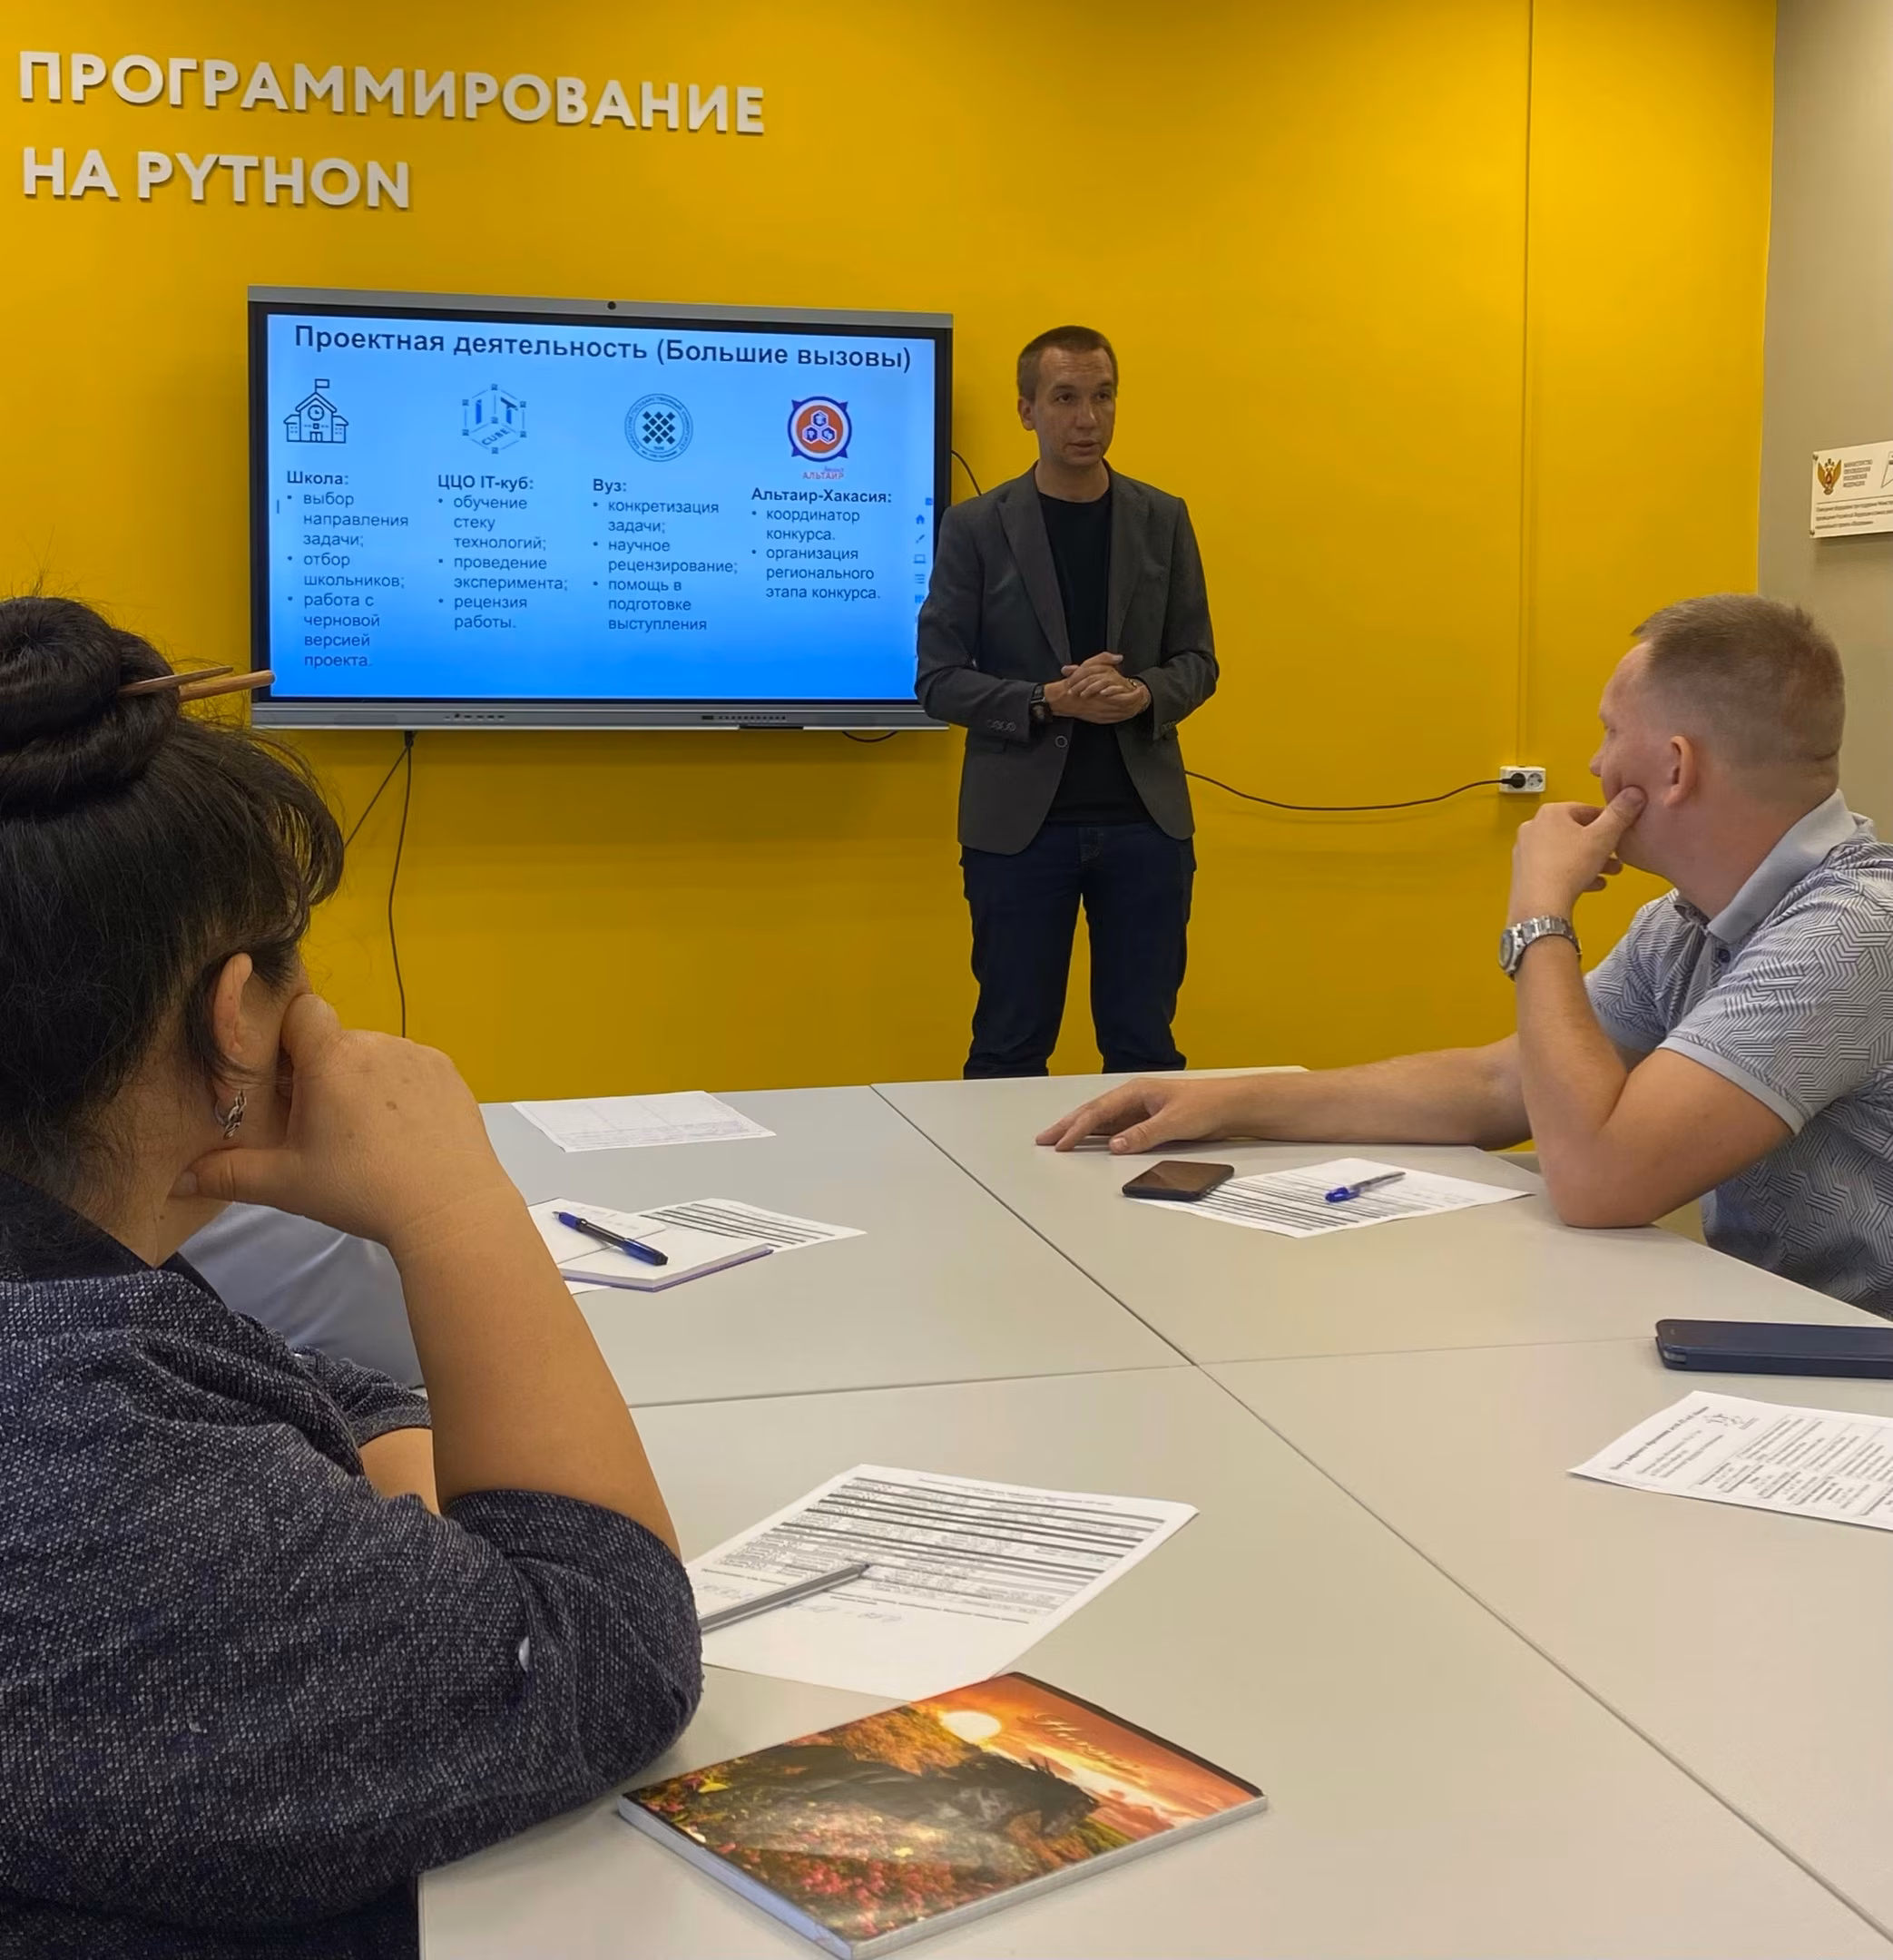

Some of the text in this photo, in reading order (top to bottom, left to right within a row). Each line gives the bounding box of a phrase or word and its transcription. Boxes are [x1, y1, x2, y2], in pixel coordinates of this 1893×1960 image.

[19, 50, 765, 134] ПРОГРАММИРОВАНИЕ
[23, 147, 410, 210] НА PYTHON
[295, 325, 911, 373] Проектная деятельность (Большие вызовы)
[287, 470, 348, 485] Школа:
[437, 475, 534, 493] ЦЦО IT-куб:
[593, 478, 627, 495] Вуз:
[303, 492, 354, 508] выбор
[751, 487, 892, 504] Альтаир-Хакасия:
[454, 495, 527, 512] обучение
[608, 501, 720, 514] конкретизация
[303, 514, 408, 528] направления
[766, 509, 860, 524] координатор
[454, 517, 495, 532] стеку
[608, 521, 665, 534] задачи;
[303, 534, 364, 548] задачи;
[454, 536, 546, 551] технологий;
[766, 529, 836, 543] конкурса.
[608, 541, 670, 554] научное
[766, 548, 858, 562] организация
[303, 552, 350, 569] отбор
[454, 557, 547, 571] проведение
[608, 560, 738, 574] рецензирование;
[766, 567, 874, 581] регионального
[304, 575, 405, 589] школьников;
[454, 577, 568, 592] эксперимента;
[608, 580, 682, 593] помощь в
[304, 593, 375, 609] работа с
[766, 587, 880, 602] этапа конкурса.
[455, 597, 527, 611] рецензия
[608, 600, 691, 612] подготовке
[303, 613, 380, 629] черновой
[455, 614, 516, 631] работы.
[608, 619, 707, 632] выступления
[304, 633, 370, 649] версией
[304, 654, 373, 669] проекта.
